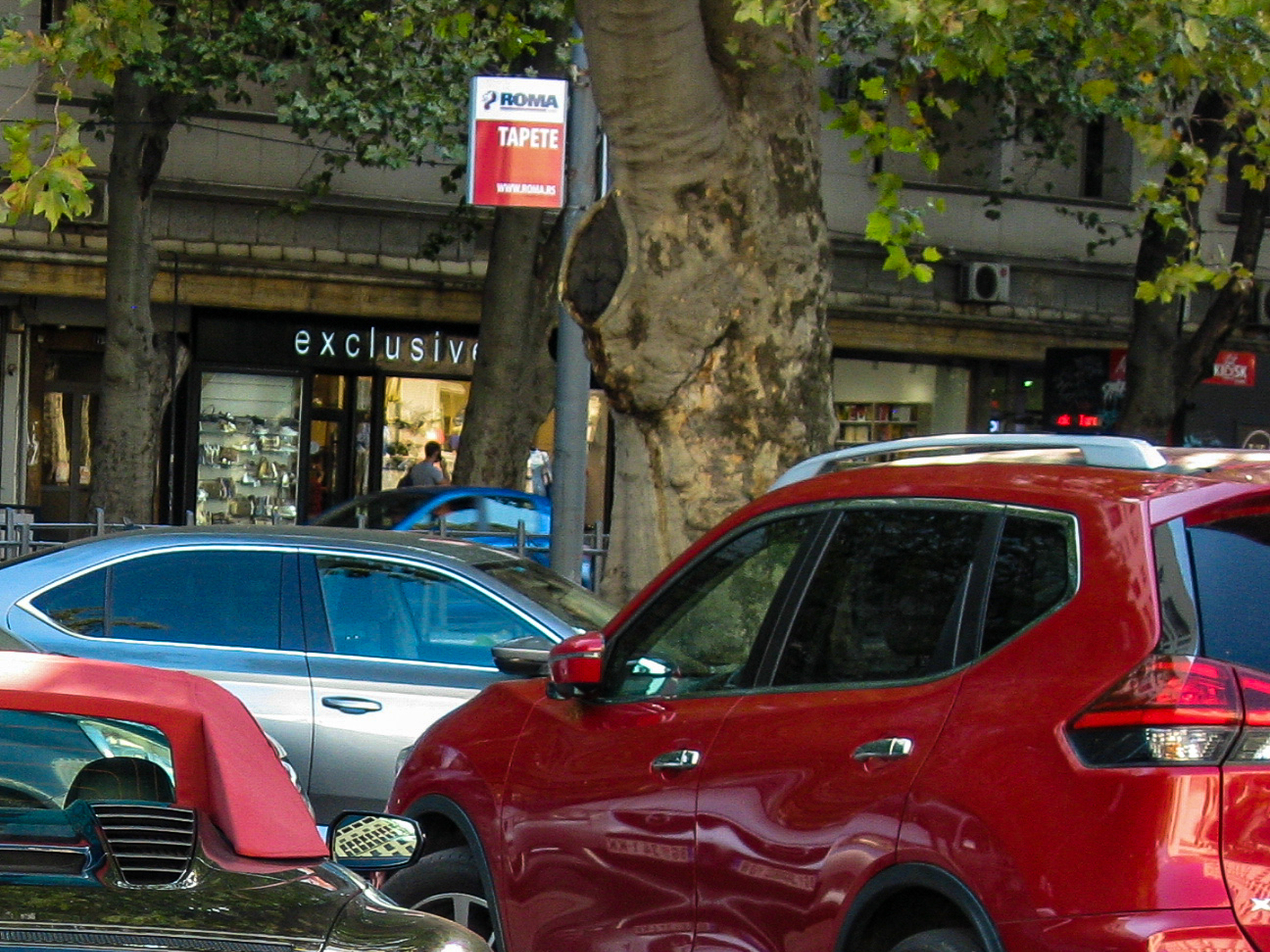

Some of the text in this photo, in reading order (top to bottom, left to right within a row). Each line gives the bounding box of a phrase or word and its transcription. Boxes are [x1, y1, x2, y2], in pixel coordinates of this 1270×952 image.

[500, 92, 559, 108] ROMA
[497, 126, 559, 149] TAPETE
[496, 183, 557, 195] WWW.ROMA.RS
